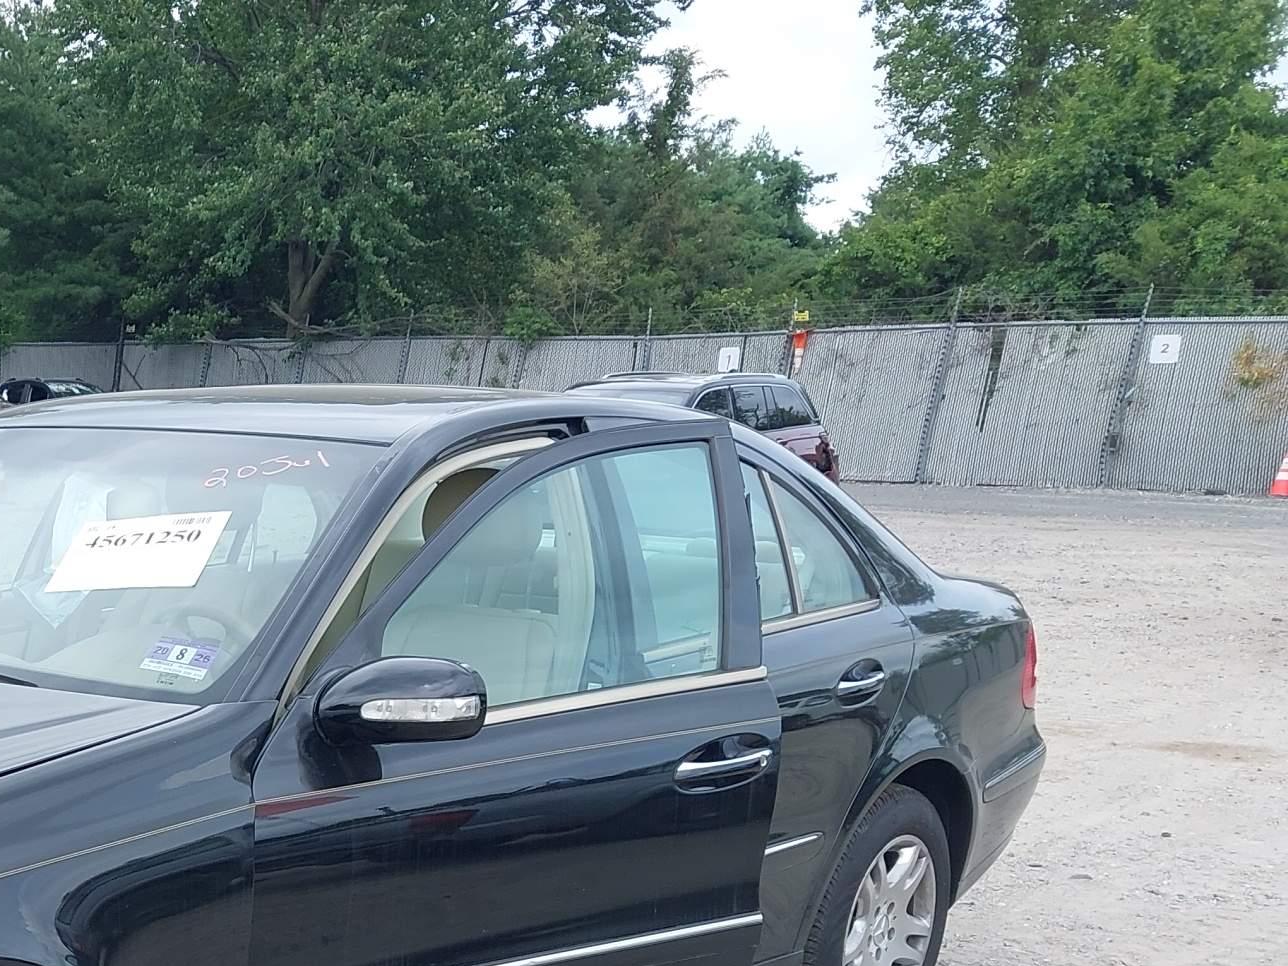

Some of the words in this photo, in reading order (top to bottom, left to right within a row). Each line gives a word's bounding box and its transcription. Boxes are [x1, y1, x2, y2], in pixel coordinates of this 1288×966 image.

[1160, 343, 1170, 354] 2
[85, 528, 202, 549] 45671250
[152, 645, 170, 656] 20
[175, 647, 189, 661] 8
[193, 653, 212, 664] 26
